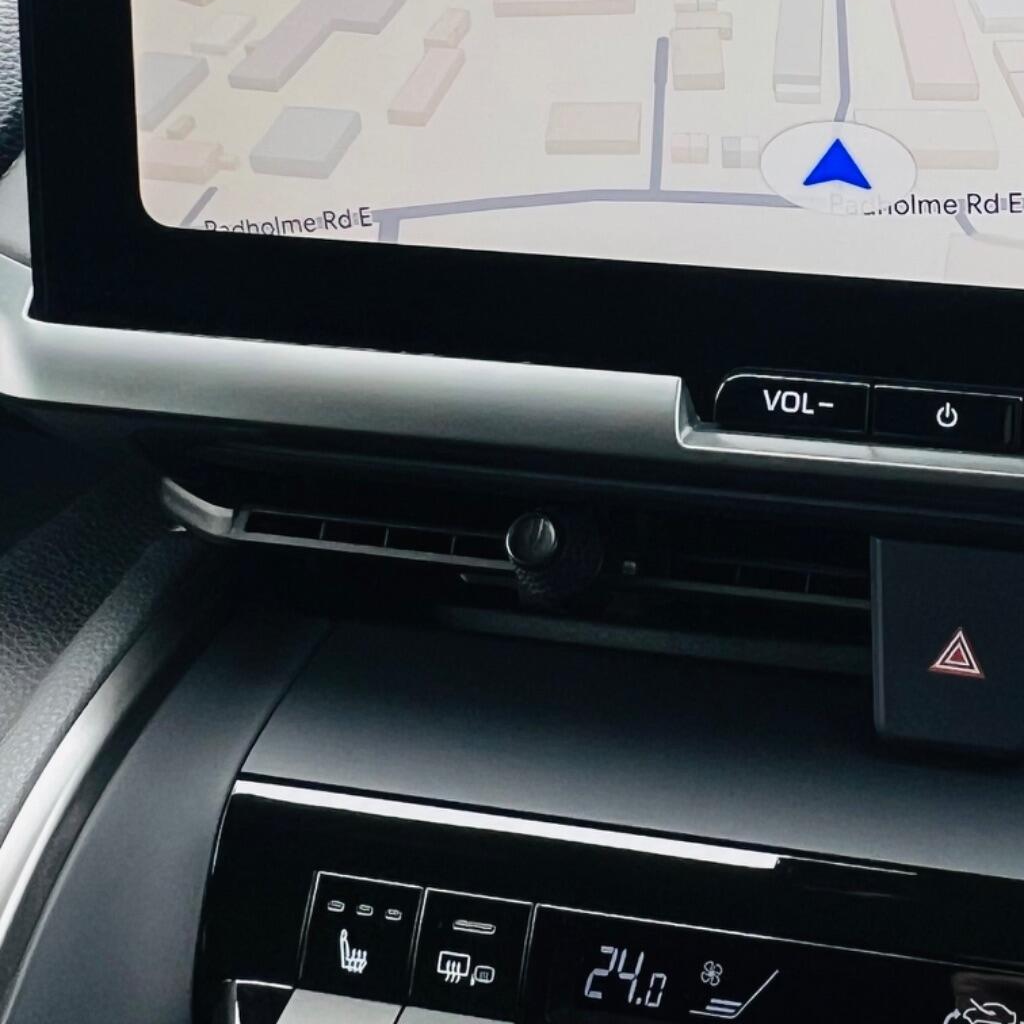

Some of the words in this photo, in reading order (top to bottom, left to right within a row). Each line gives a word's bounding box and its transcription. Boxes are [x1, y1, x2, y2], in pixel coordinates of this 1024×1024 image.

[967, 193, 999, 215] Rd
[1009, 192, 1023, 214] E
[322, 209, 351, 230] Rd
[359, 206, 373, 227] E
[584, 945, 667, 1007] 24.0
